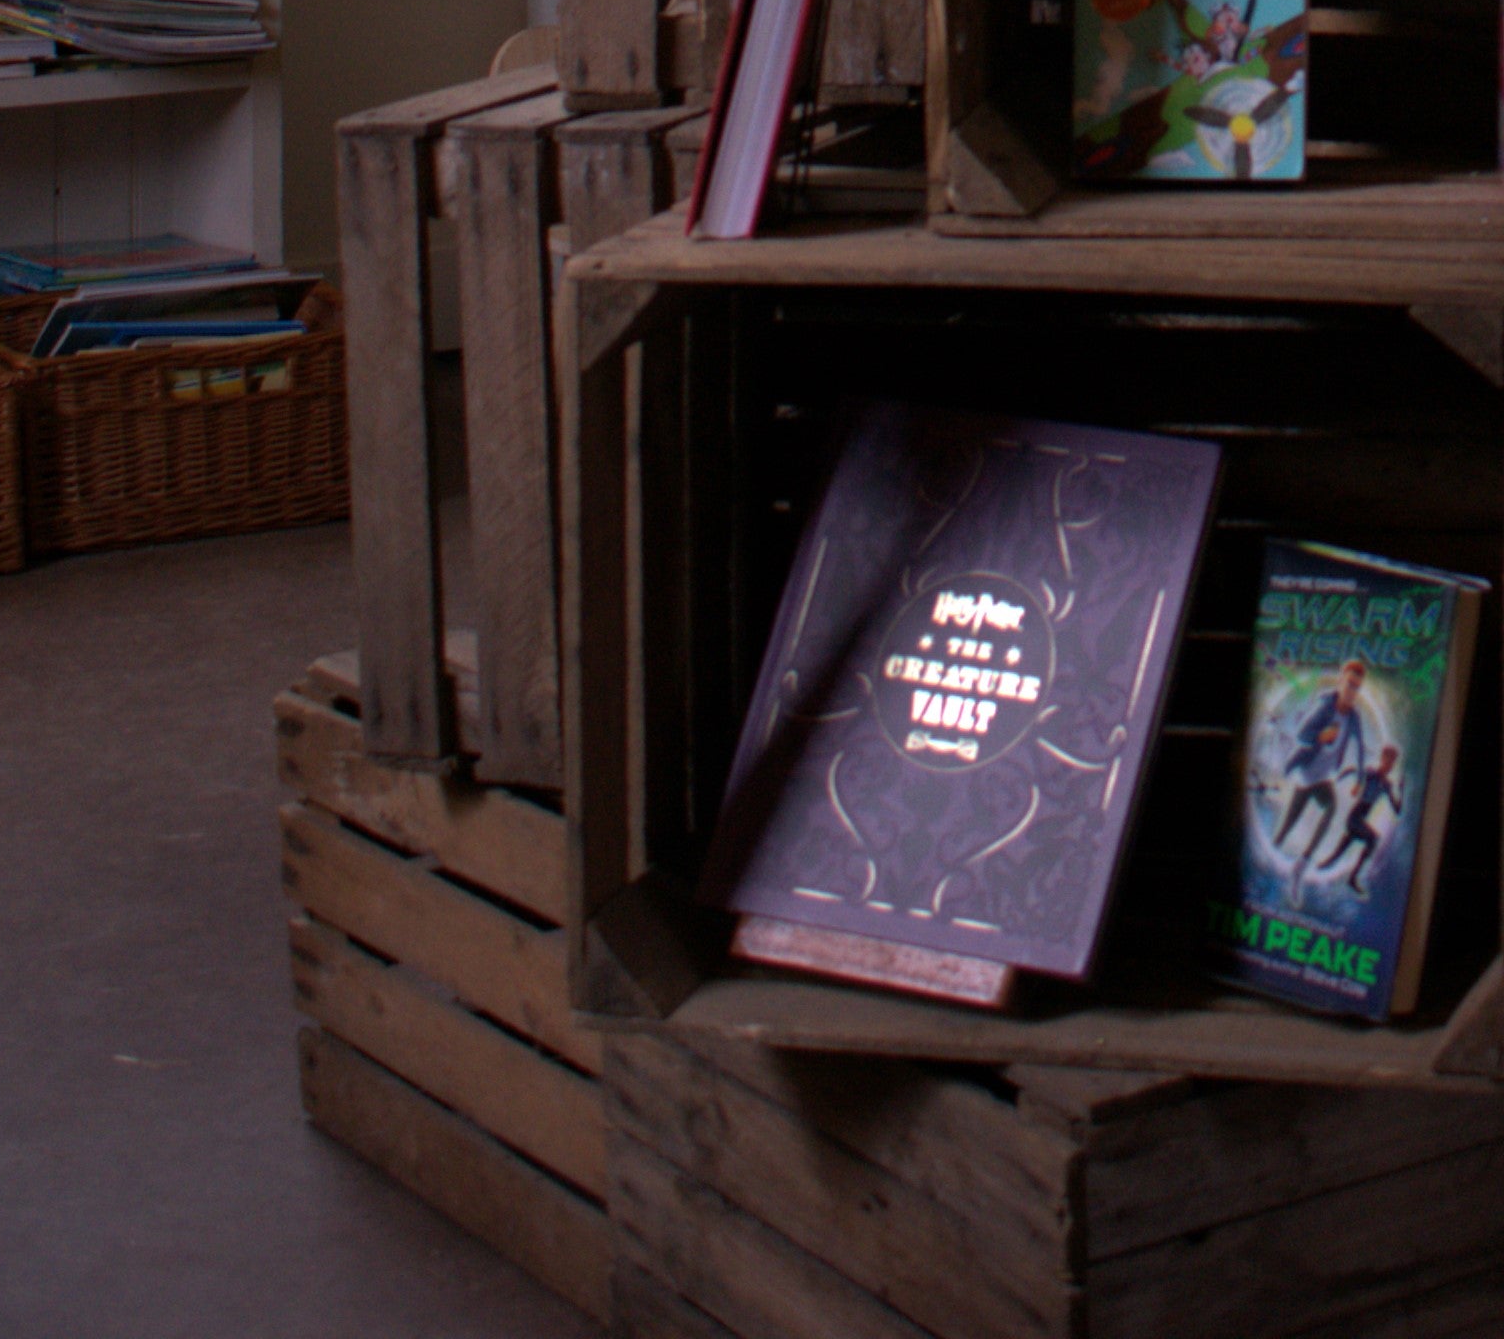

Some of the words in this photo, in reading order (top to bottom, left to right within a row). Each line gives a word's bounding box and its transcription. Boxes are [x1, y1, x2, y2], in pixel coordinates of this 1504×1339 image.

[1253, 591, 1443, 639] SWARM
[946, 636, 995, 662] THE
[1273, 629, 1416, 669] RISING
[883, 653, 1042, 704] CREATURE
[910, 688, 998, 736] VAULT
[1204, 898, 1264, 948] TIM
[1263, 918, 1383, 987] PEAKE
